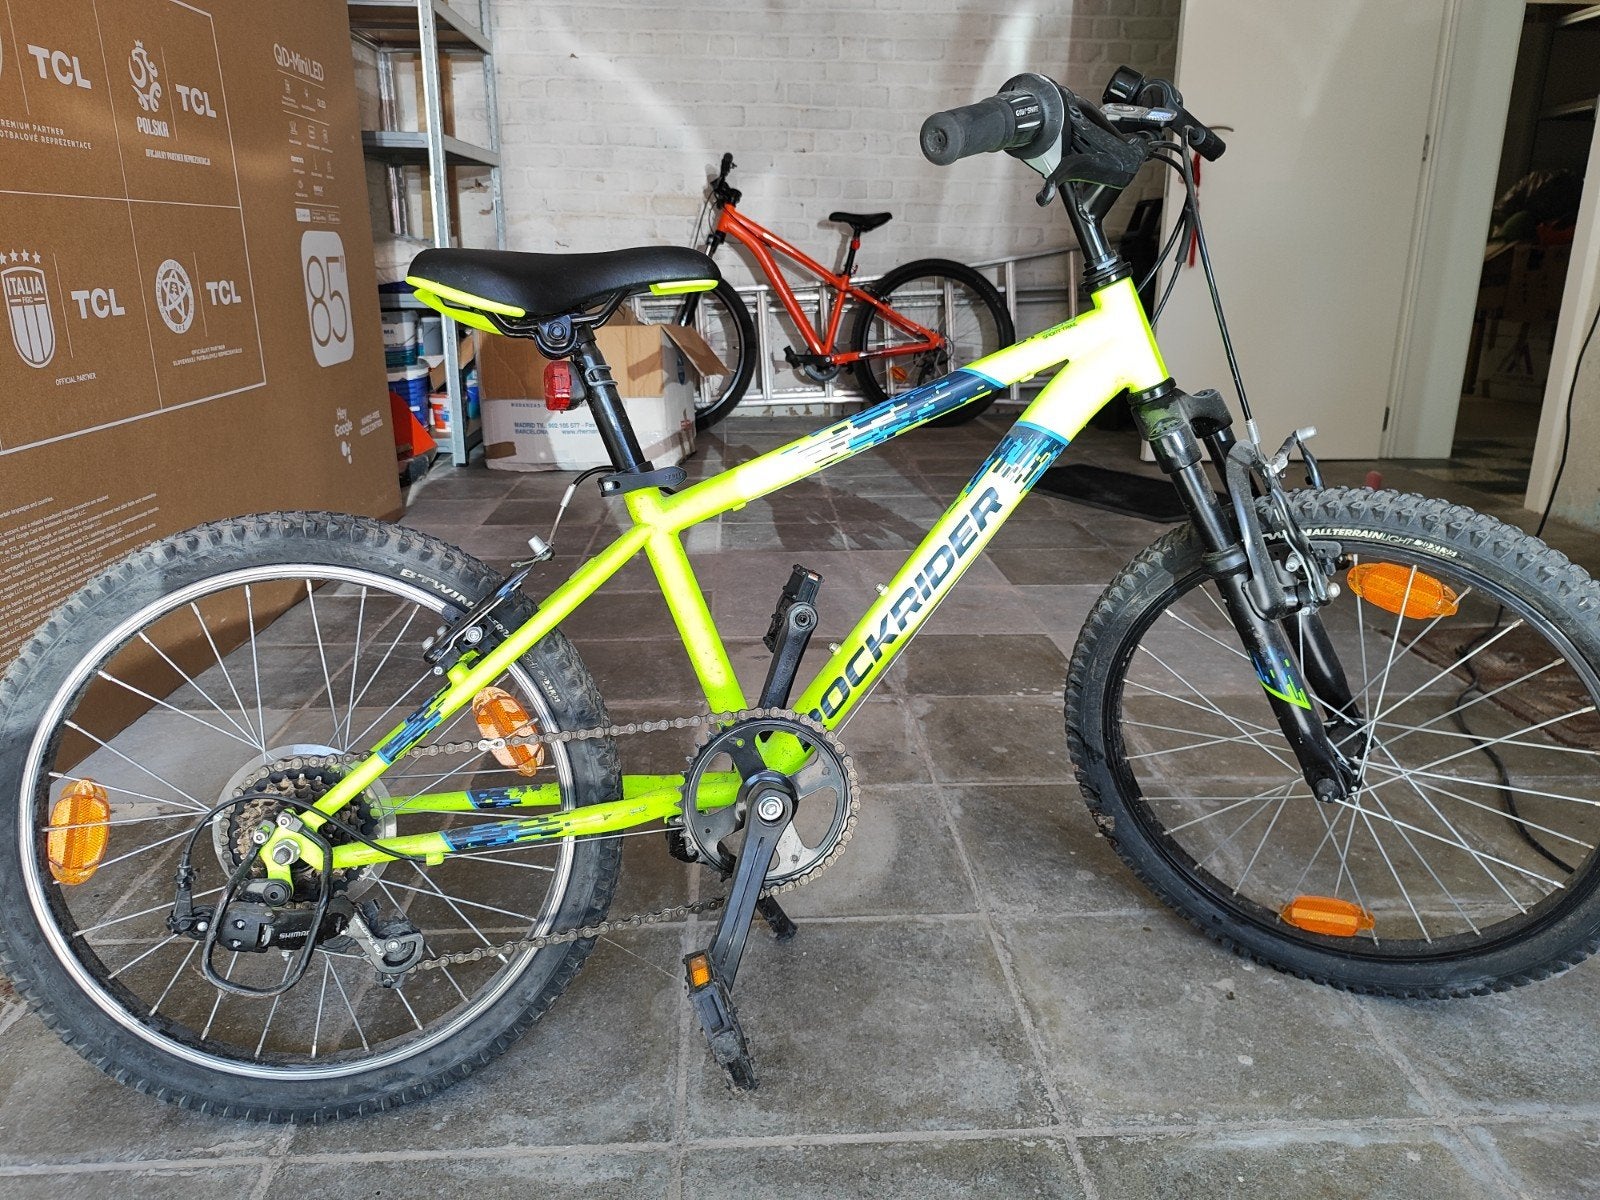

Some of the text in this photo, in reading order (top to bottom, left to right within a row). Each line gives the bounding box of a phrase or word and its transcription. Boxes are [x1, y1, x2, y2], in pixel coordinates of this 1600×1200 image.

[27, 43, 92, 90] TCL
[175, 83, 217, 119] TCL
[0, 118, 65, 136] REMIUM PARTNER
[0, 129, 92, 150] OTBALOVÉ REPREZENTACE
[136, 116, 170, 138] POLSKA
[5, 276, 45, 296] ITALIA
[206, 280, 242, 306] TCL
[71, 288, 126, 320] TCL
[306, 255, 348, 348] 85
[335, 419, 353, 437] Google
[807, 486, 1003, 724] OCKRIDER
